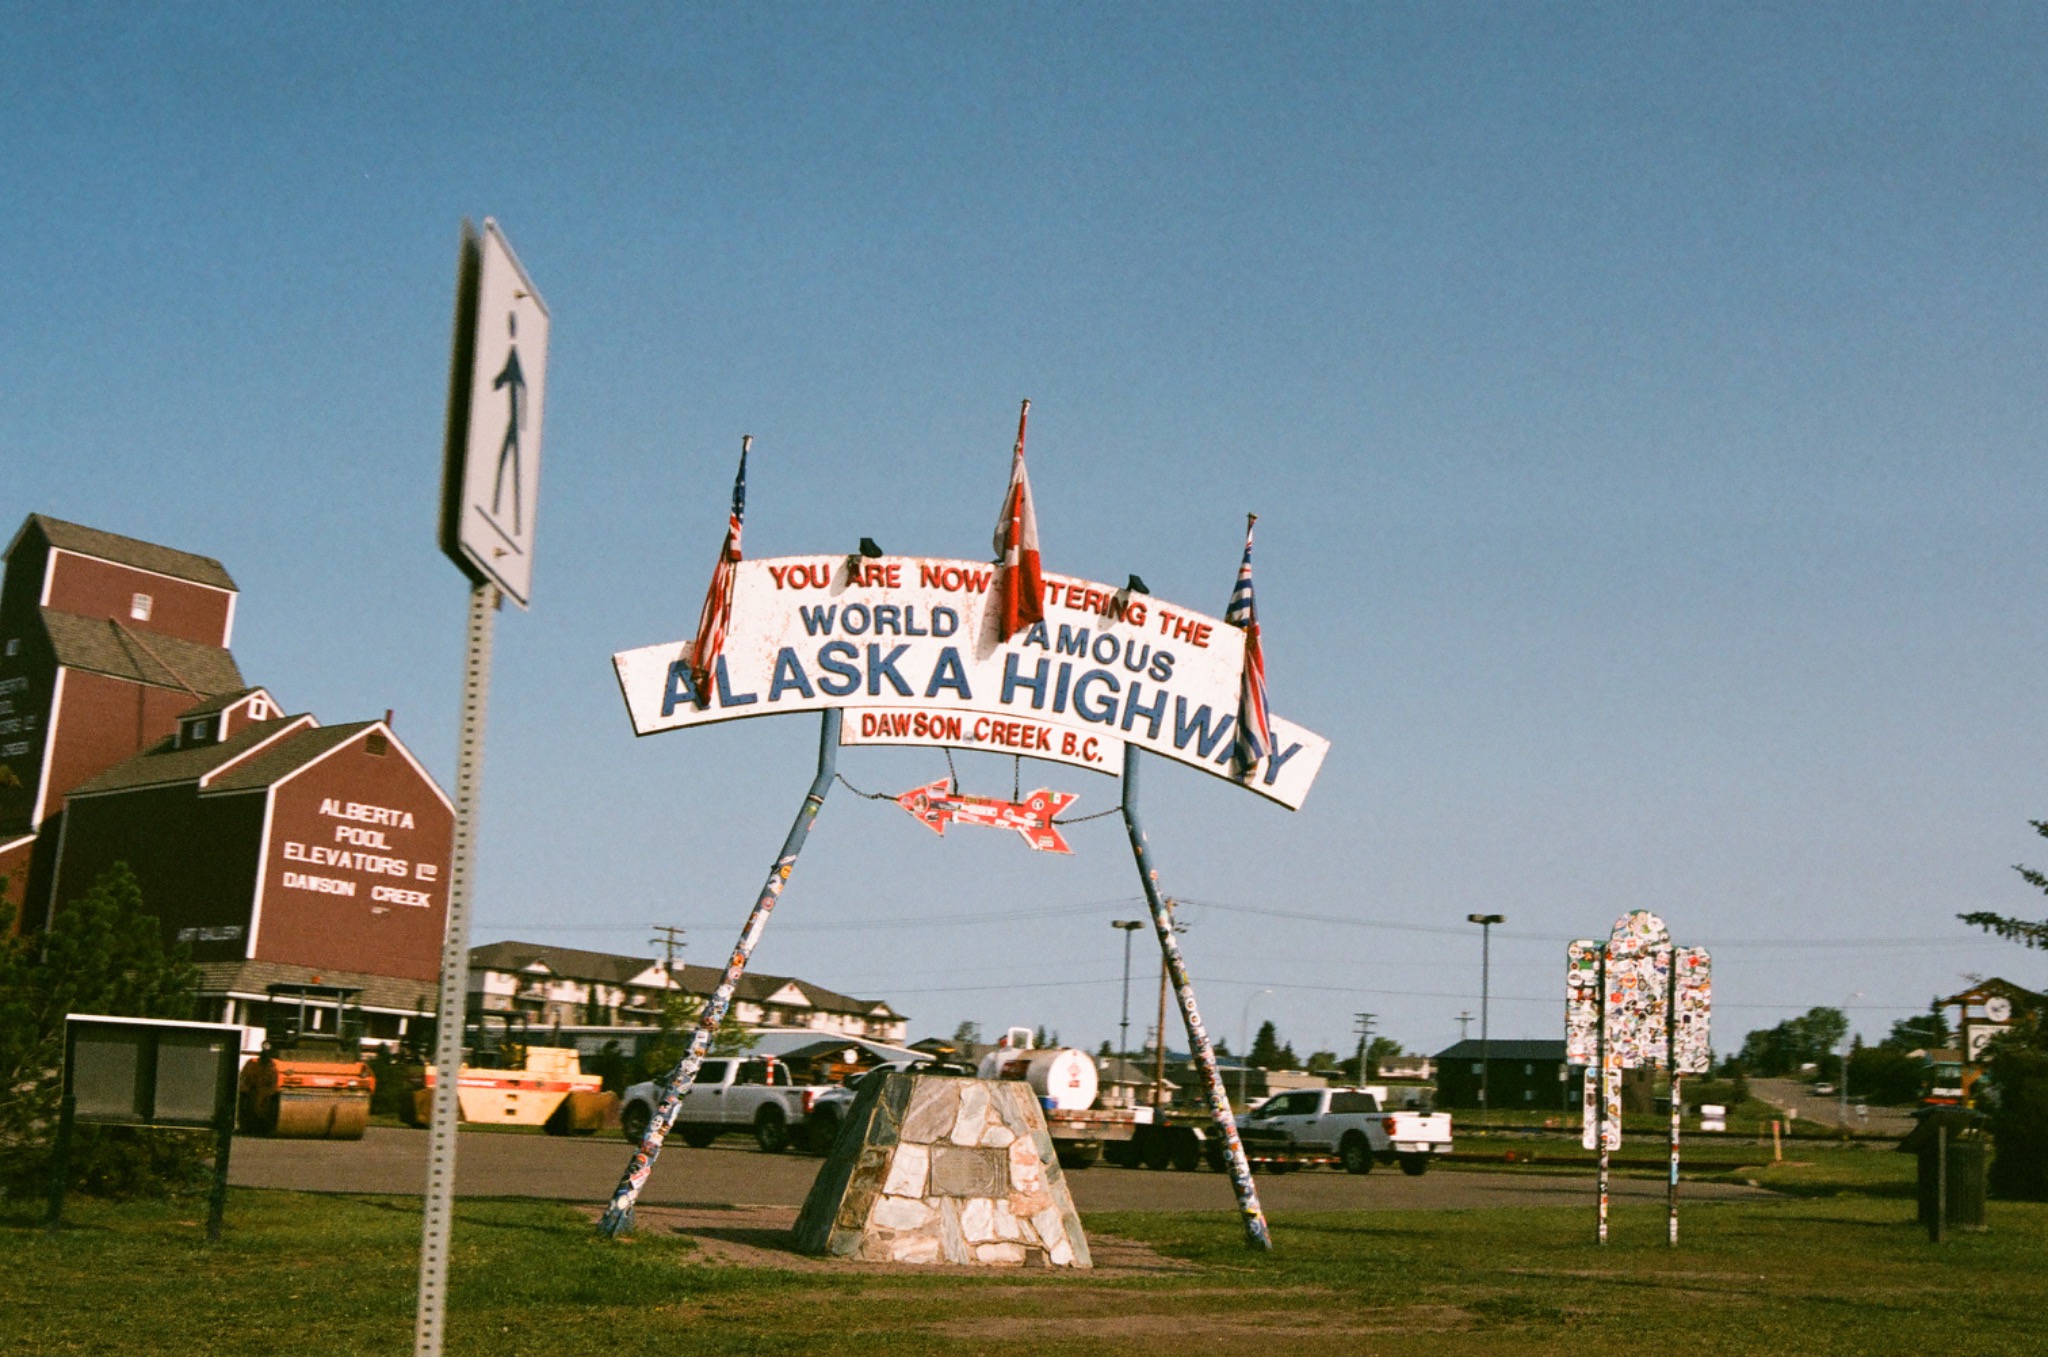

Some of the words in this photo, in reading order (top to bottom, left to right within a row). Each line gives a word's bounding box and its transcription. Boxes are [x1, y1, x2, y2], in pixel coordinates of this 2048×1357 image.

[770, 564, 830, 590] YOU
[845, 564, 902, 589] ARE
[921, 565, 993, 594] NOW
[1040, 579, 1148, 628] TERING
[1158, 610, 1213, 649] THE
[800, 603, 959, 638] WORLD
[1023, 618, 1176, 683] AMOUS
[661, 641, 973, 717] ALASKA
[862, 712, 962, 741] DAWSON
[974, 717, 1052, 751] CREEK
[1061, 732, 1104, 763] B.C.
[318, 798, 415, 830] ALBERTA
[283, 841, 409, 877] ELEVATORS
[334, 825, 392, 850] POOL
[283, 872, 356, 897] DAWSON
[370, 885, 432, 908] CREEK
